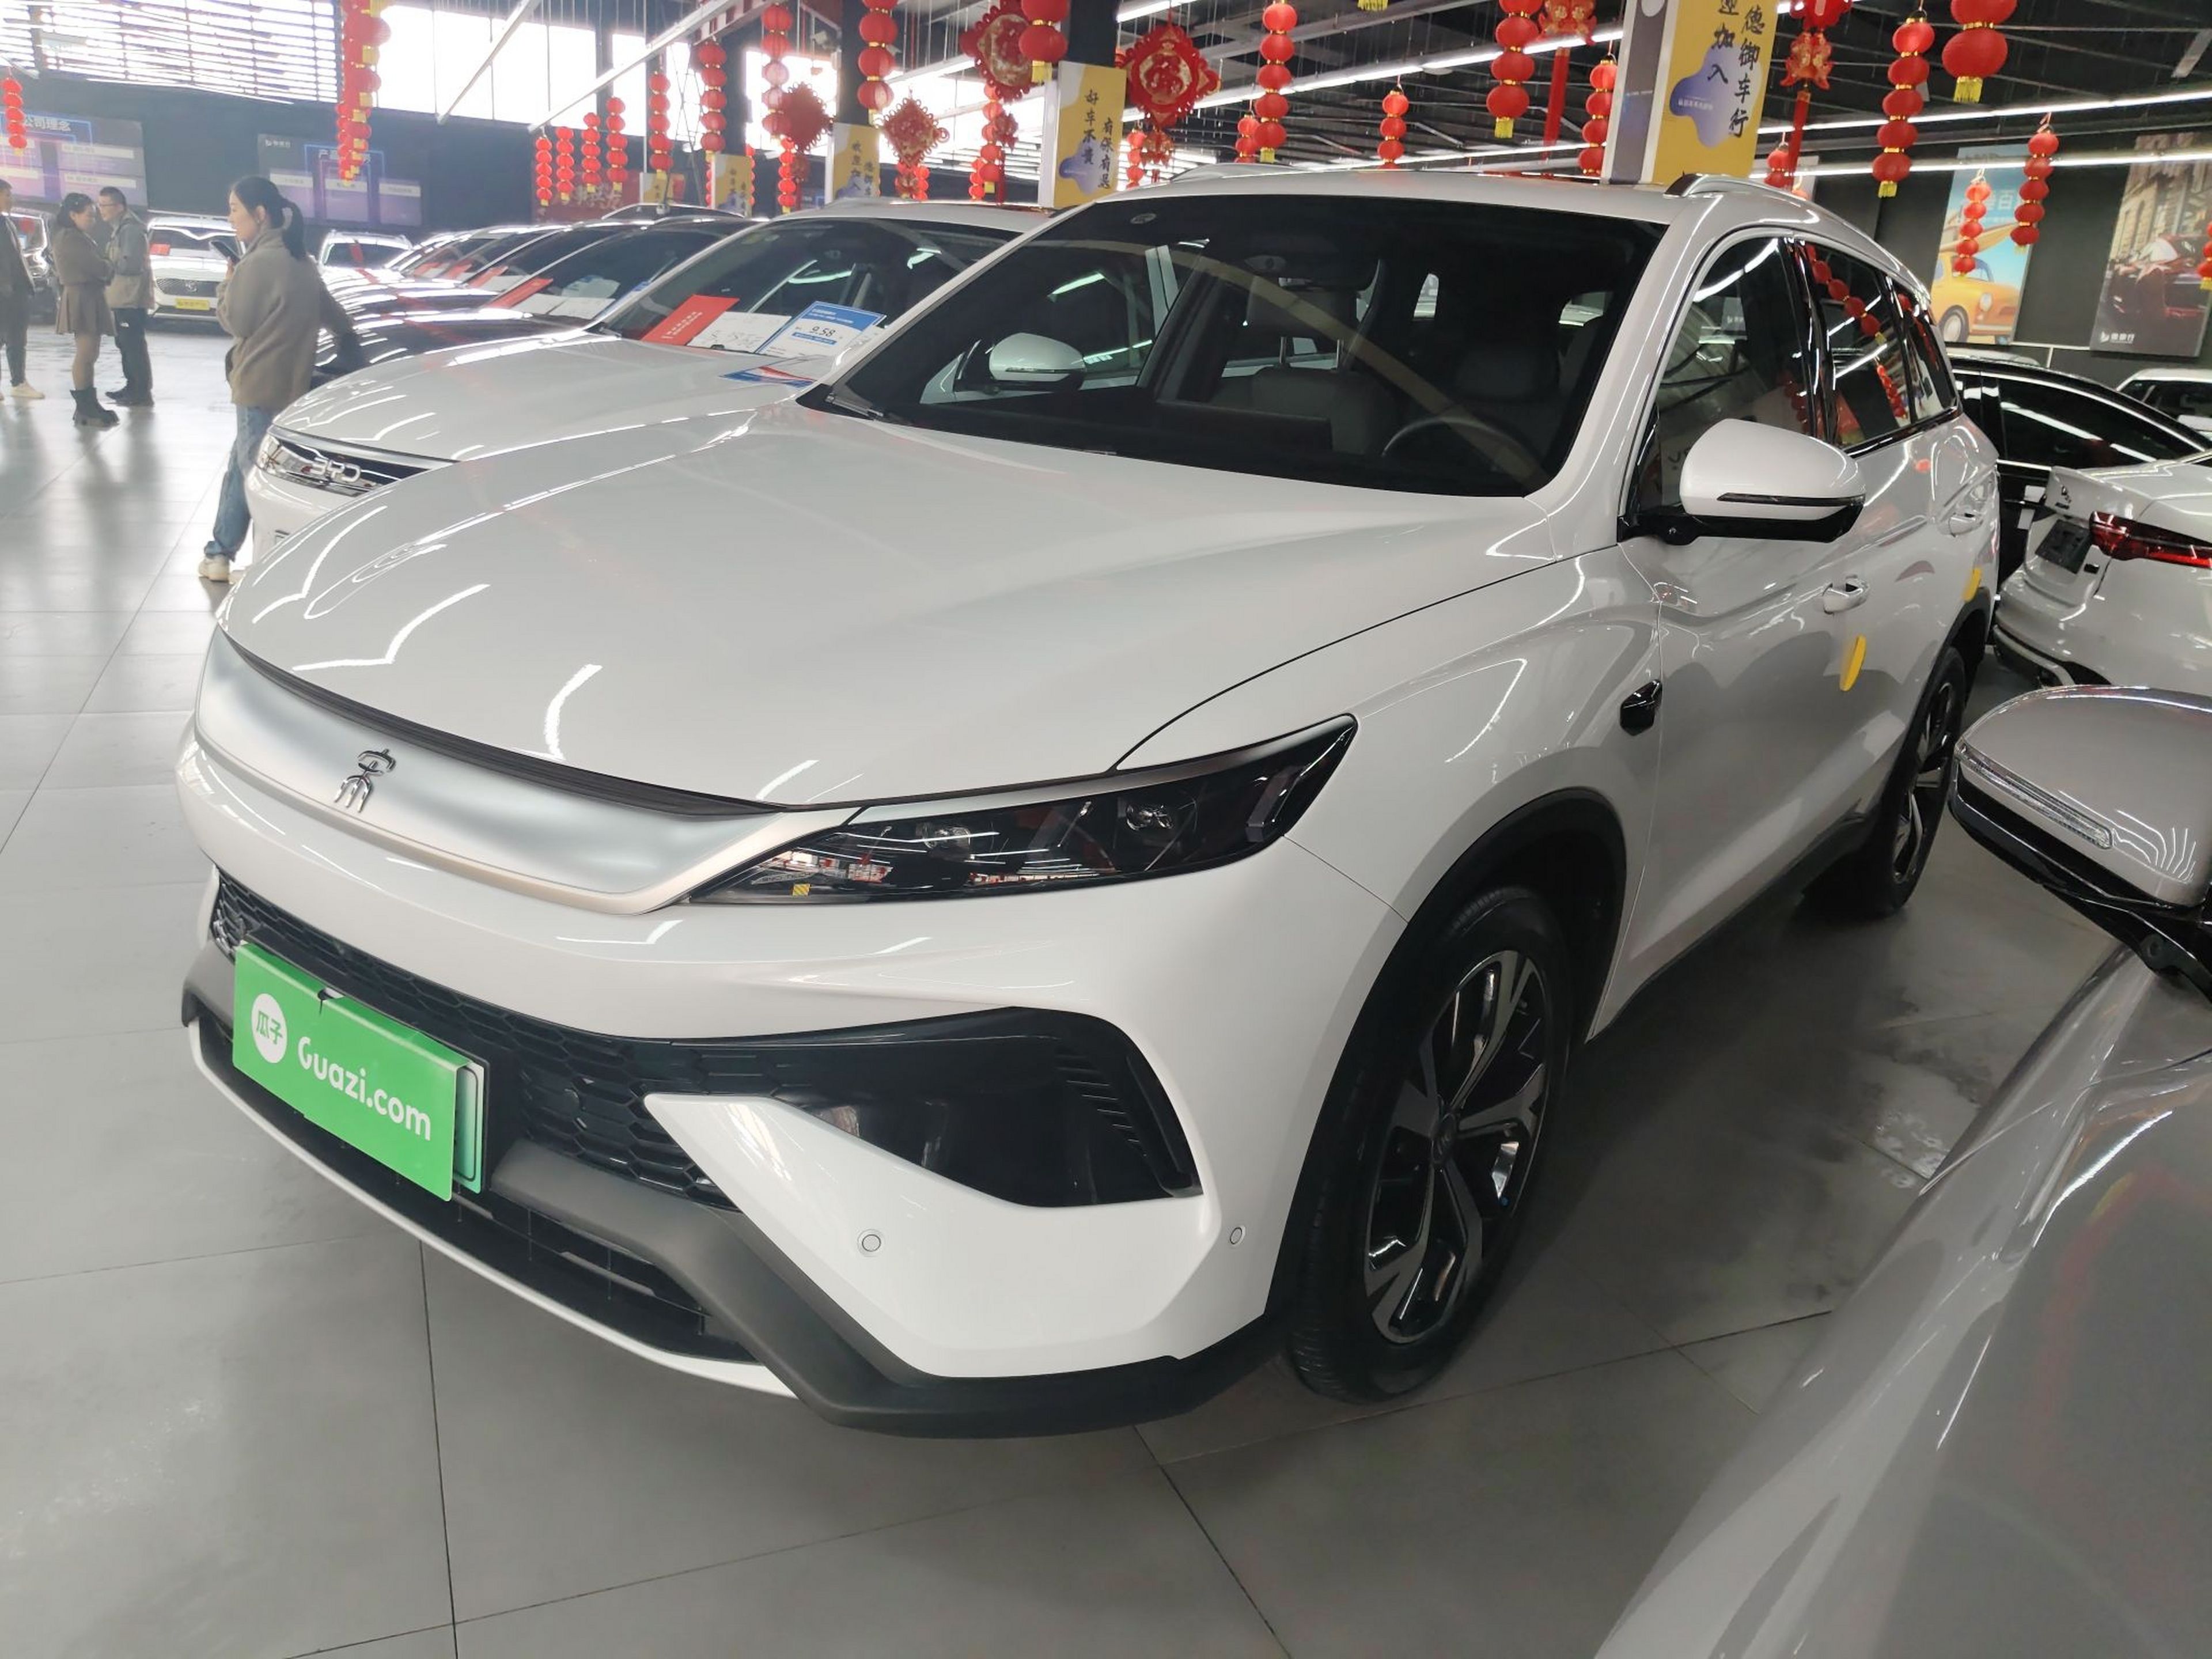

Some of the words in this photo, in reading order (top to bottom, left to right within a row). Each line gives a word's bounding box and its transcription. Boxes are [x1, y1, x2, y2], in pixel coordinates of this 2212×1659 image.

[1728, 5, 1766, 138] 德御车行
[809, 325, 836, 337] 9.58
[309, 457, 361, 482] BYD
[256, 1010, 283, 1045] 瓜子
[298, 1036, 431, 1141] Guazi.com
